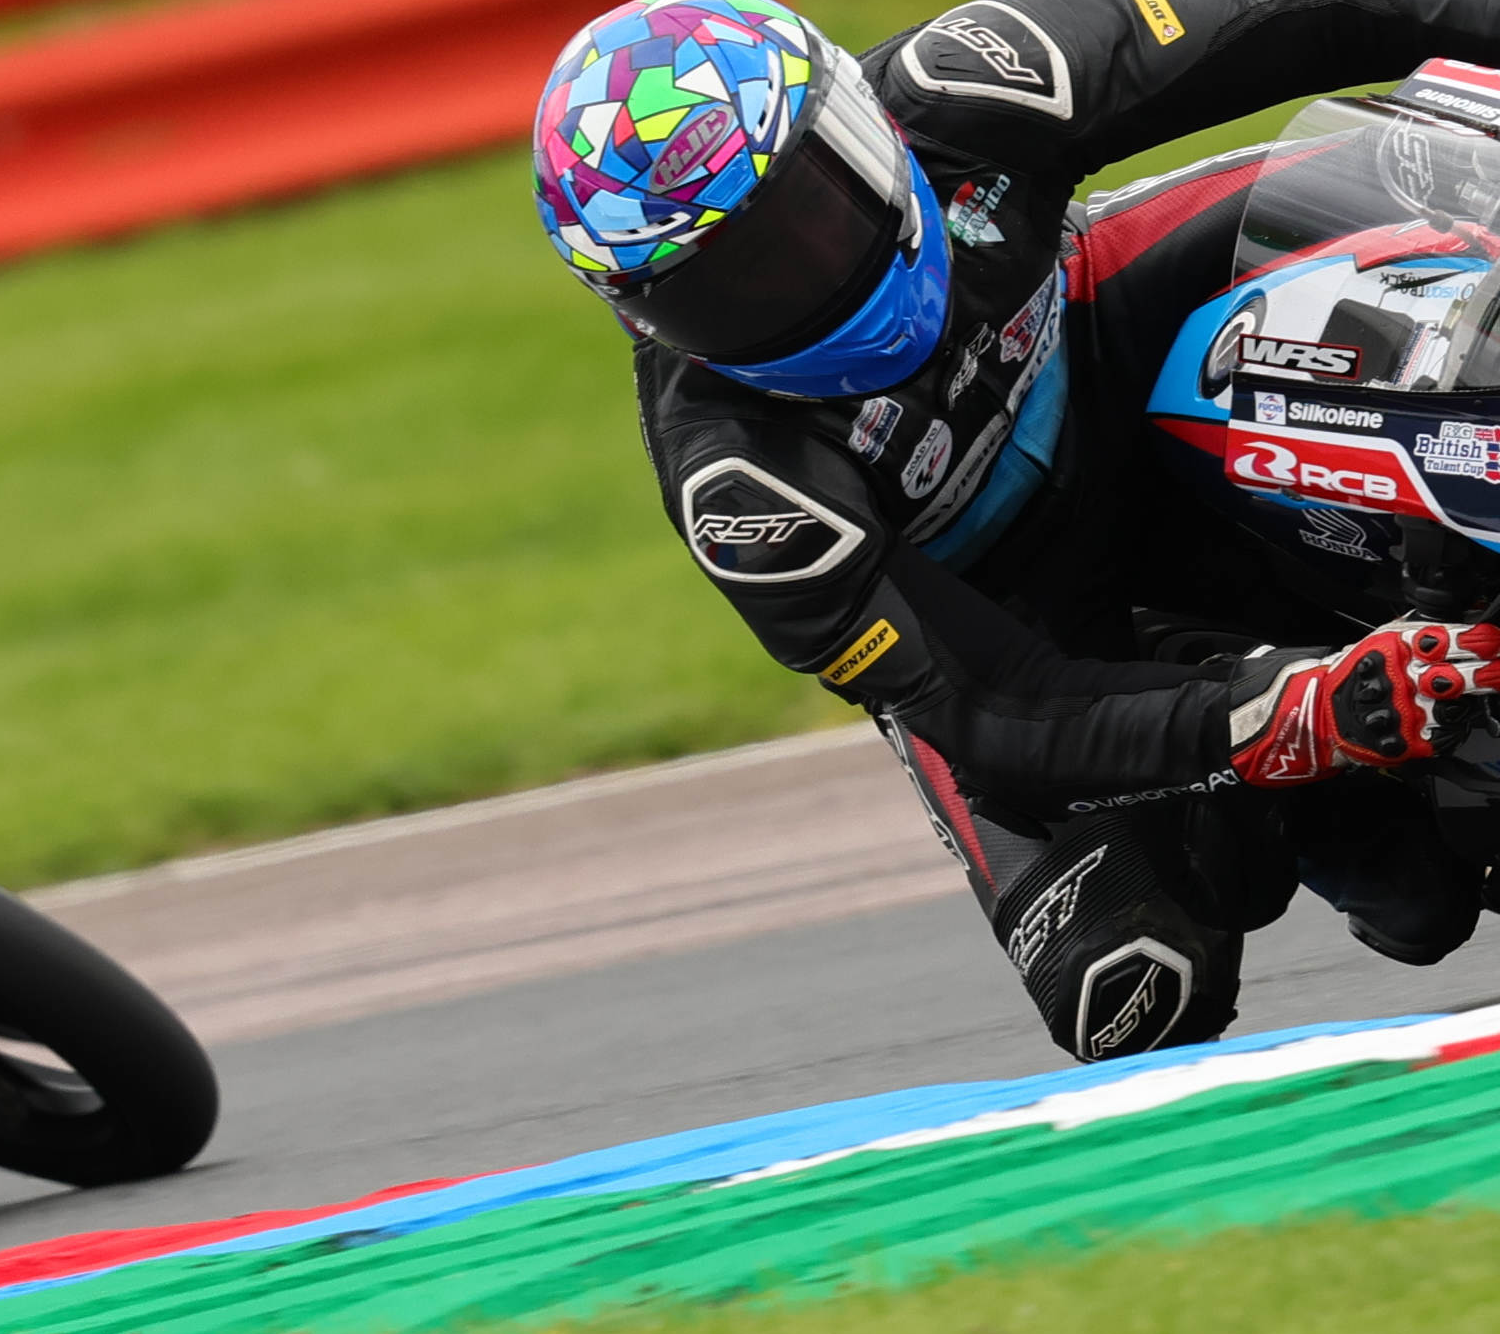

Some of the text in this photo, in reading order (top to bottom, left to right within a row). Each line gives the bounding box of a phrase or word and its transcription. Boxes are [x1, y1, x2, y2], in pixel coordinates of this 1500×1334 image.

[932, 17, 1044, 85] RST
[659, 110, 724, 184] HJC
[962, 173, 1011, 247] RAPIDO
[1241, 337, 1357, 373] WRS
[1257, 401, 1384, 429] FUCHS Silkolene
[905, 427, 938, 477] ROAD TO
[1417, 436, 1483, 459] British
[1426, 459, 1485, 477] Talent Cup
[1300, 461, 1397, 501] RCB
[693, 513, 818, 544] RST
[1299, 529, 1382, 561] HONDA
[830, 627, 891, 682] DUNLOP
[1008, 844, 1109, 979] RST
[1092, 962, 1162, 1058] RST
